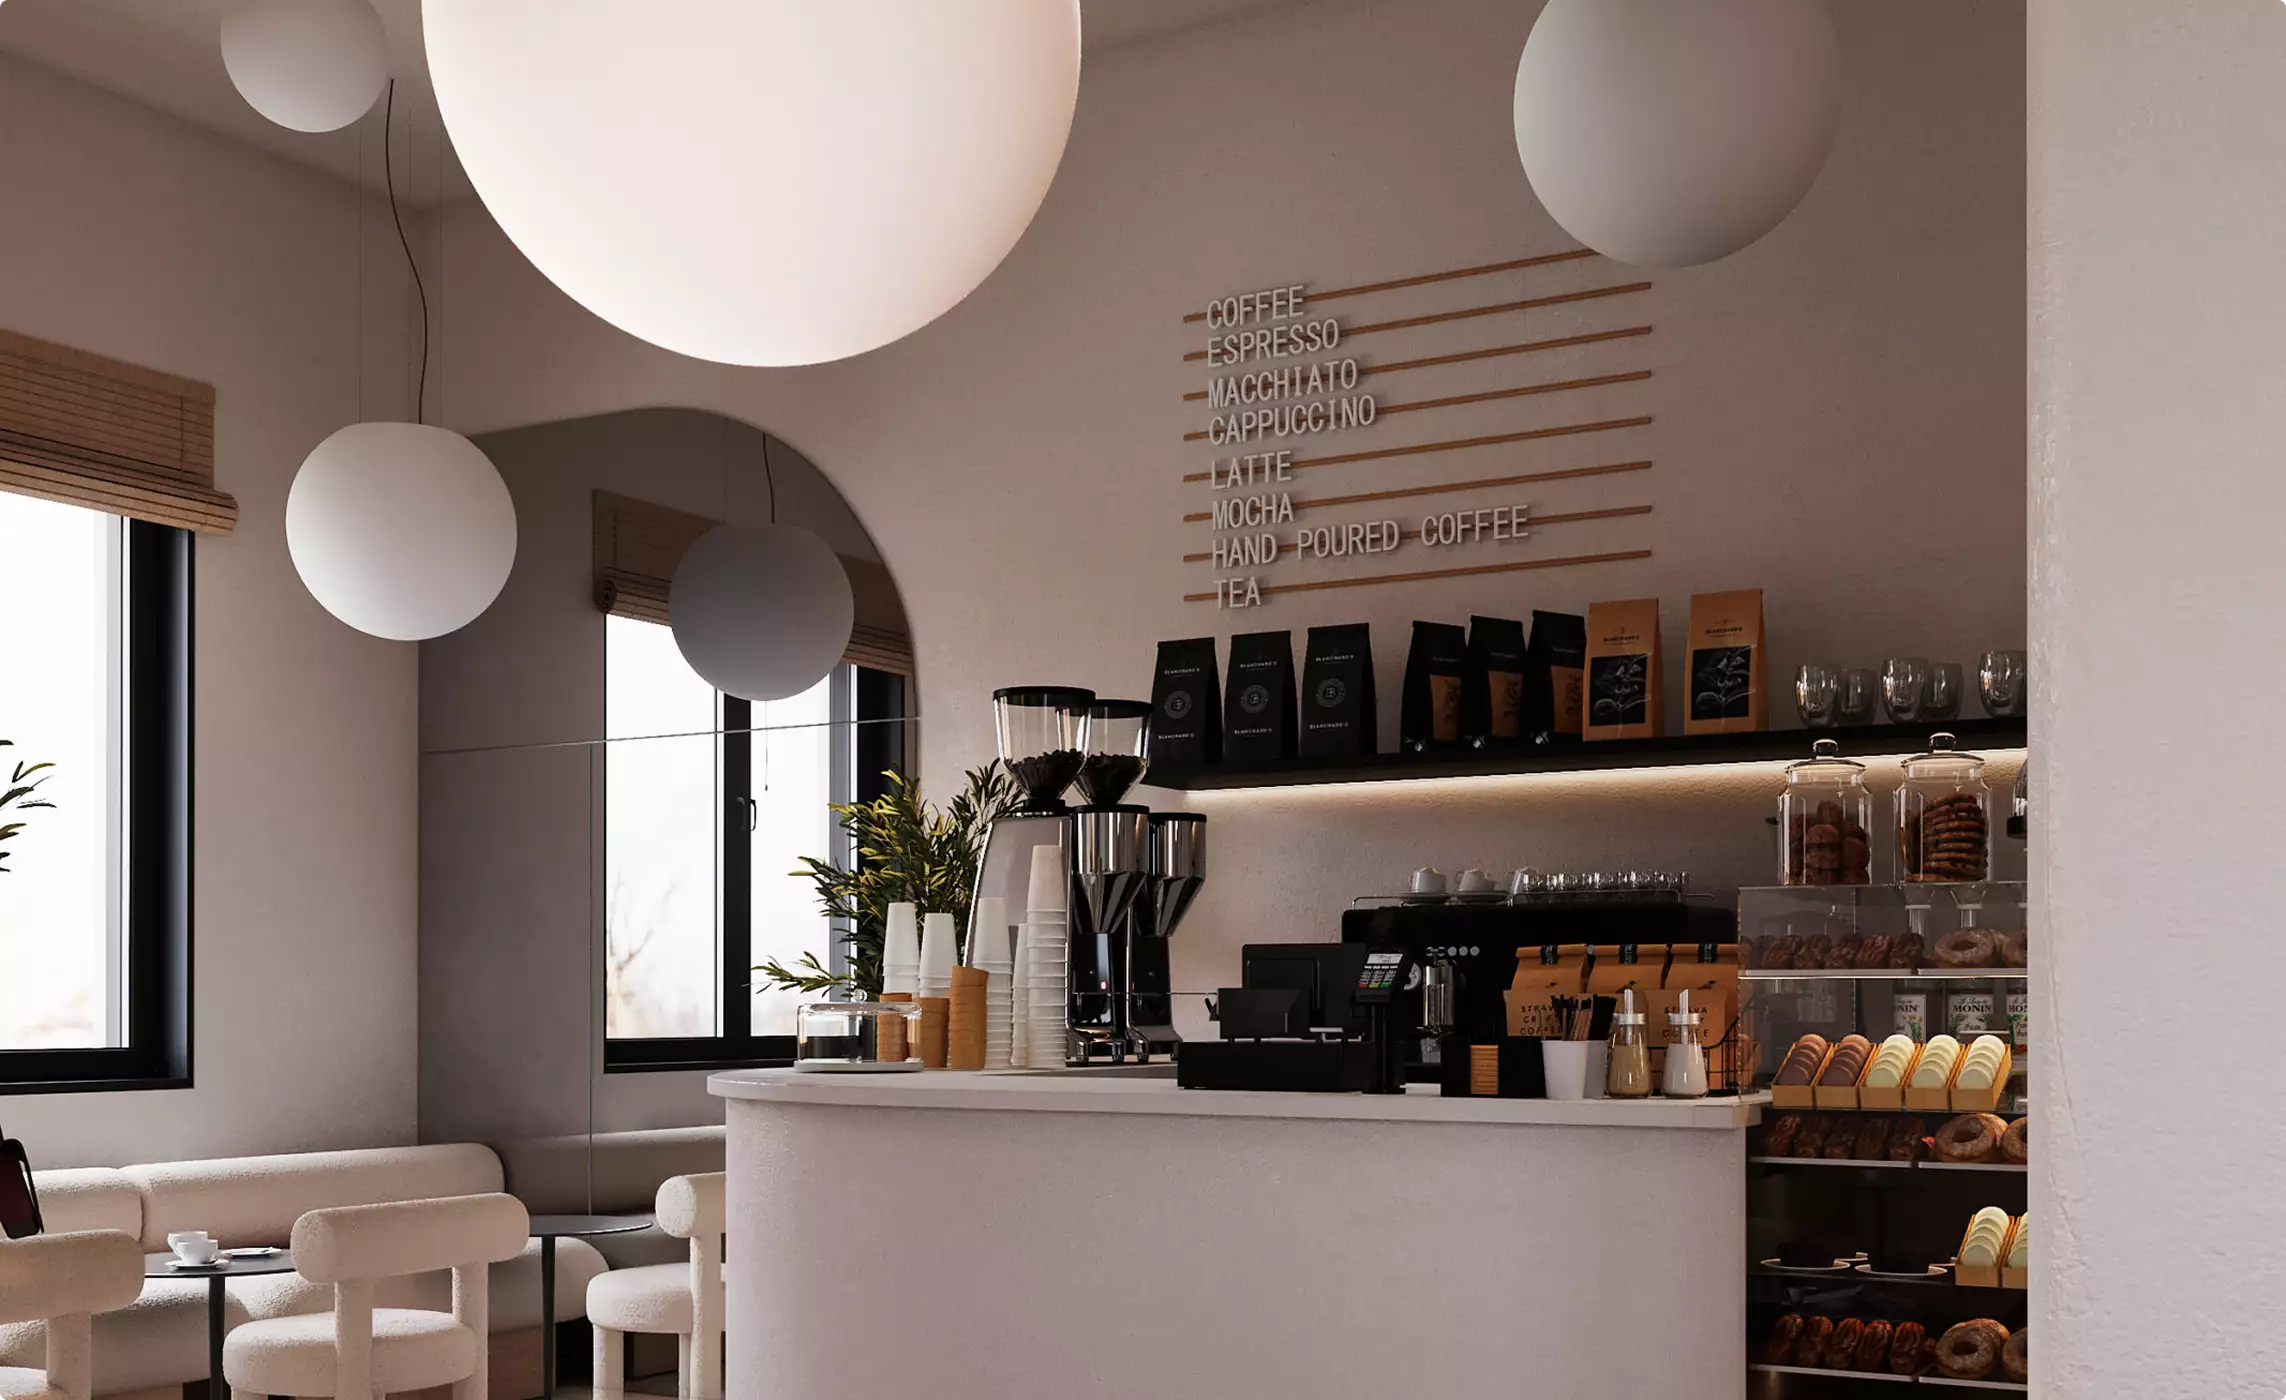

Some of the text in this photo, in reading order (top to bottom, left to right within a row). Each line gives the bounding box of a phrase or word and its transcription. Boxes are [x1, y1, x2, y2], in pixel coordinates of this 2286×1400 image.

[1206, 285, 1304, 330] COFFEE
[1207, 319, 1339, 368] ESPRESSO
[1208, 358, 1357, 409] MACCHIATO
[1208, 395, 1376, 446] CAPPUCCINO
[1211, 450, 1292, 490] LATTE
[1212, 493, 1294, 531] MOCHA
[1212, 504, 1528, 569] HAND POURED COFFEE
[1213, 577, 1261, 610] TEA
[1663, 1006, 1708, 1014] STAVA
[1953, 1004, 1992, 1013] MONIN
